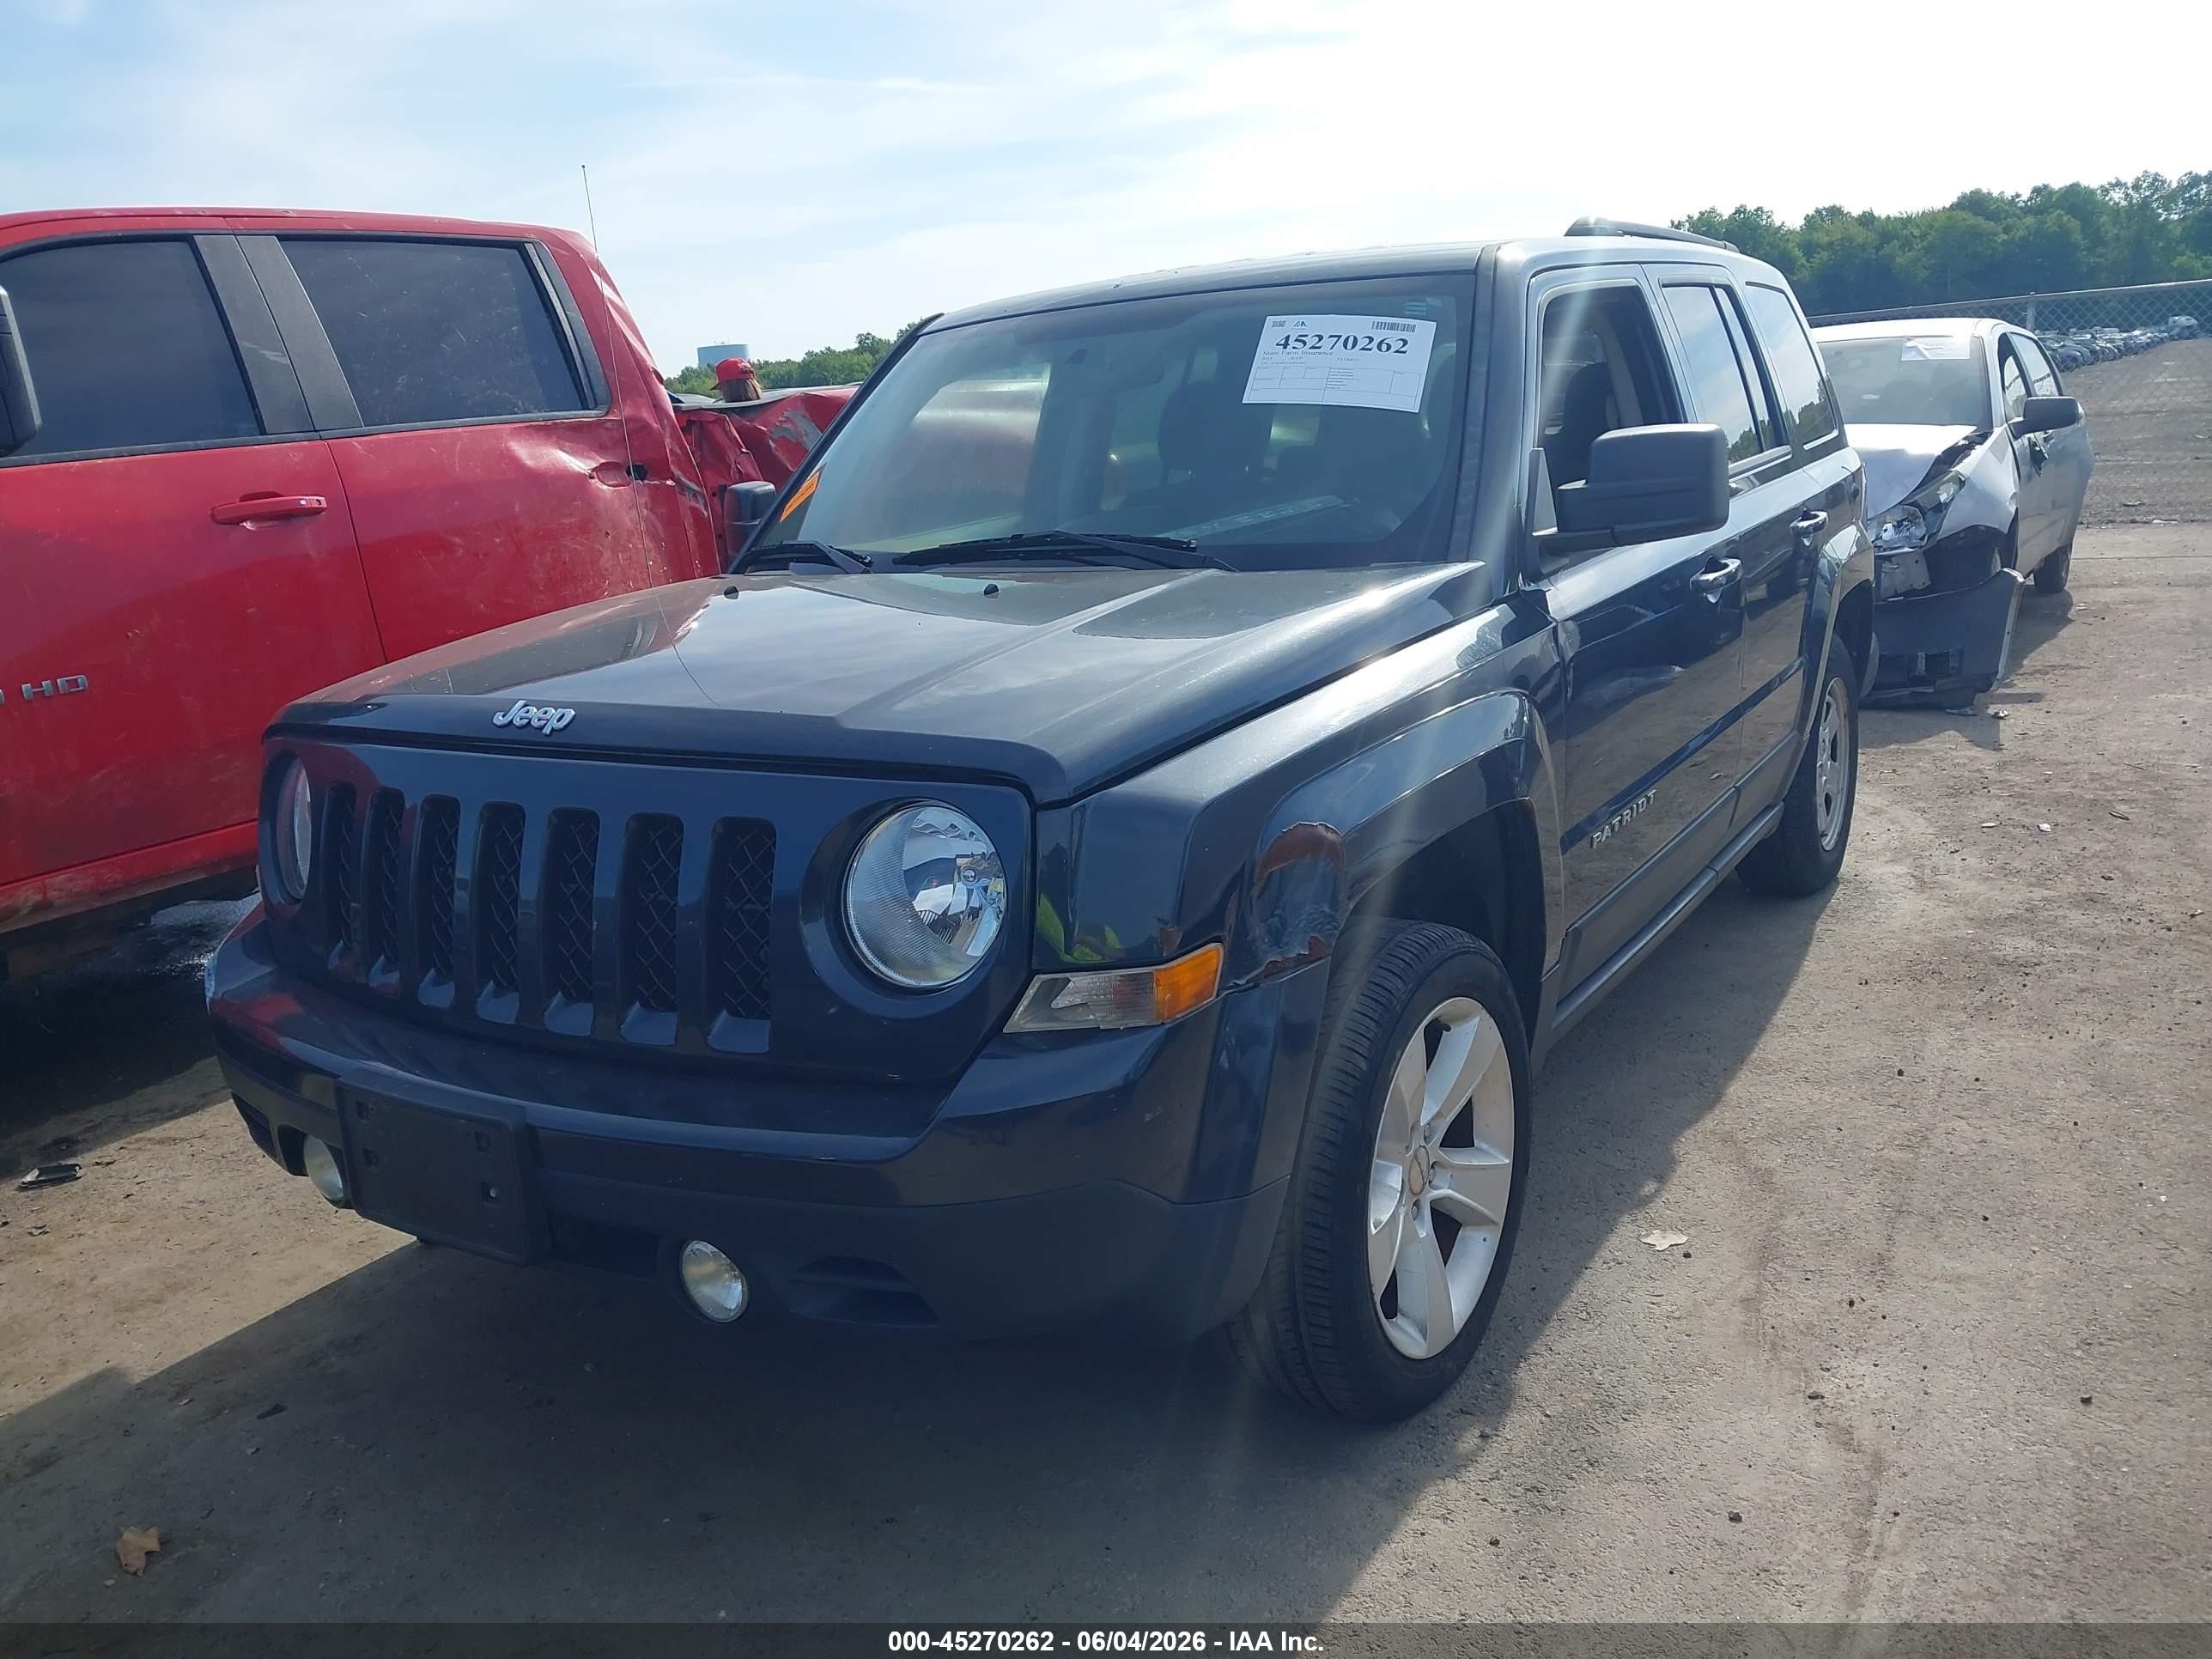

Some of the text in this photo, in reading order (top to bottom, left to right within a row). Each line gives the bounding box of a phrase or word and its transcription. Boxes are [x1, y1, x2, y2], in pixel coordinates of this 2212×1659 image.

[1275, 333, 1409, 355] 45270262
[21, 674, 88, 701] HD
[492, 700, 576, 736] Jeep
[1591, 789, 1657, 849] PATRIOT
